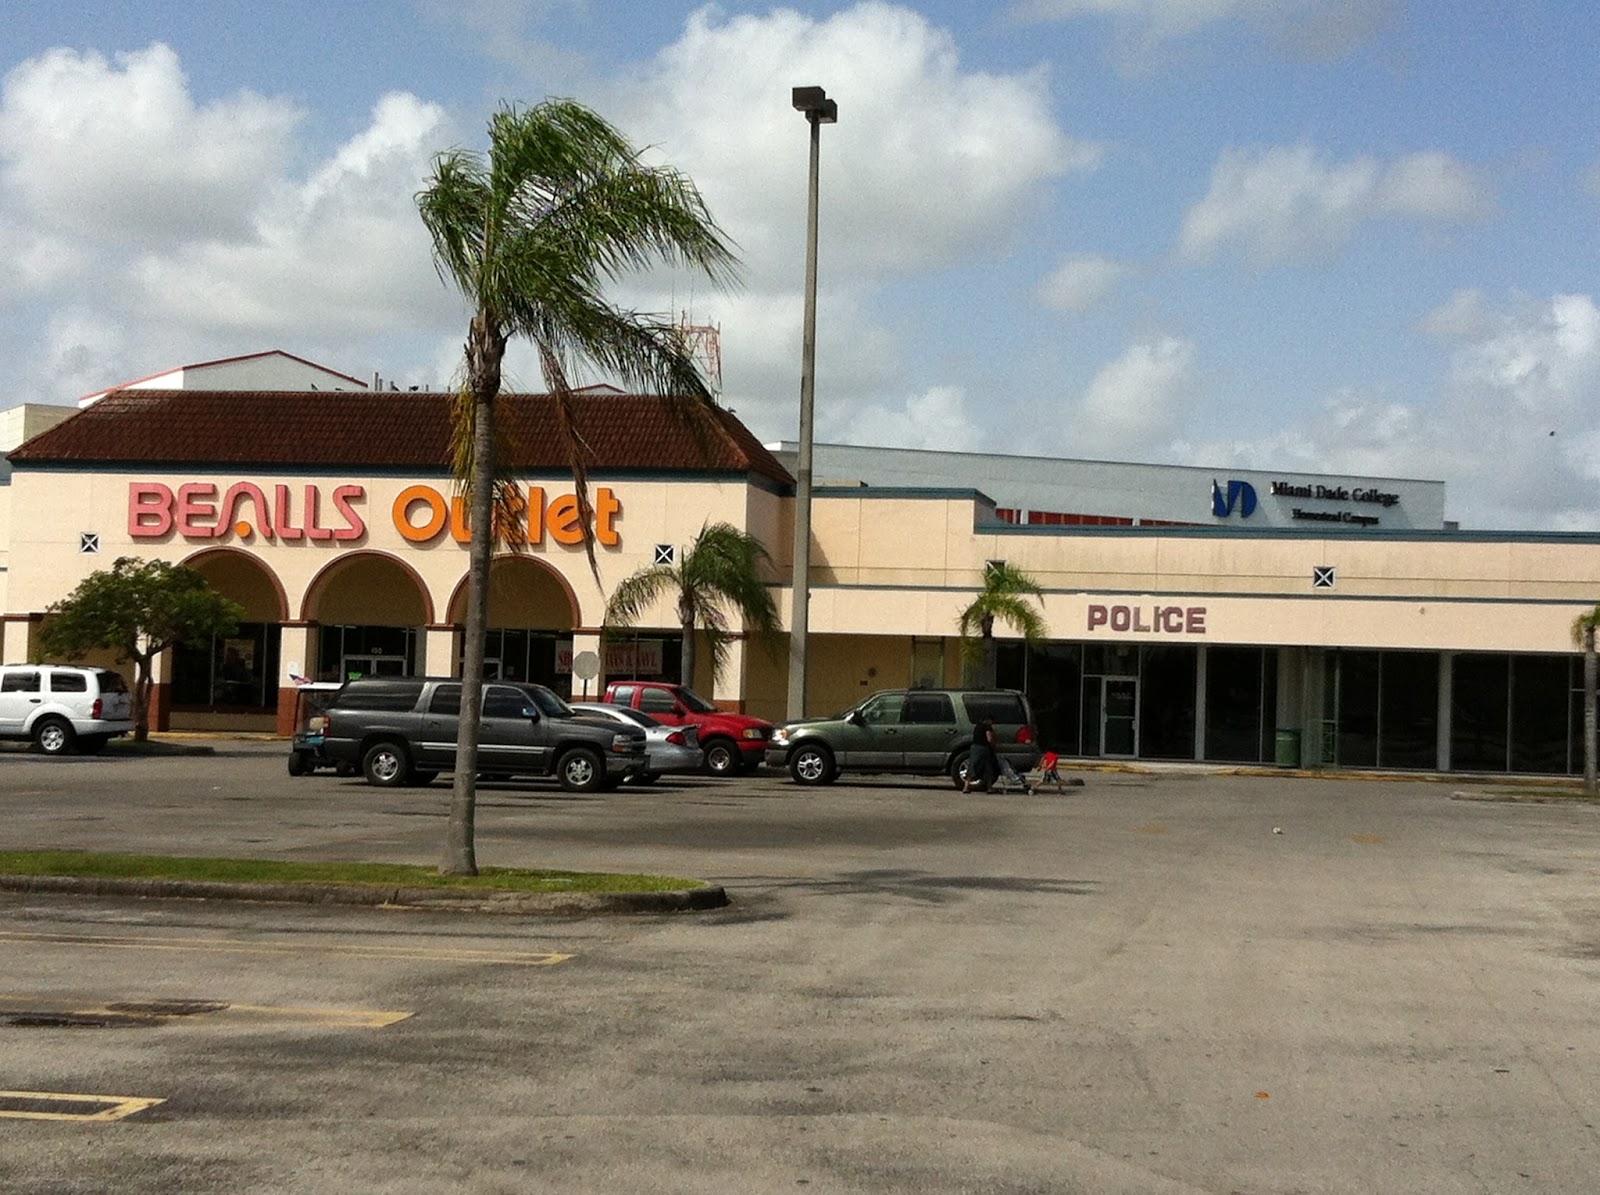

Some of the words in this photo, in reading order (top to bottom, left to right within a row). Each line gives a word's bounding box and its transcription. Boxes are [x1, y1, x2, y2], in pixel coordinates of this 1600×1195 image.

[1270, 481, 1312, 498] Miami
[1316, 485, 1349, 501] Dade
[1352, 487, 1400, 508] College
[128, 481, 367, 541] BEALLS
[1087, 604, 1207, 634] POLICE
